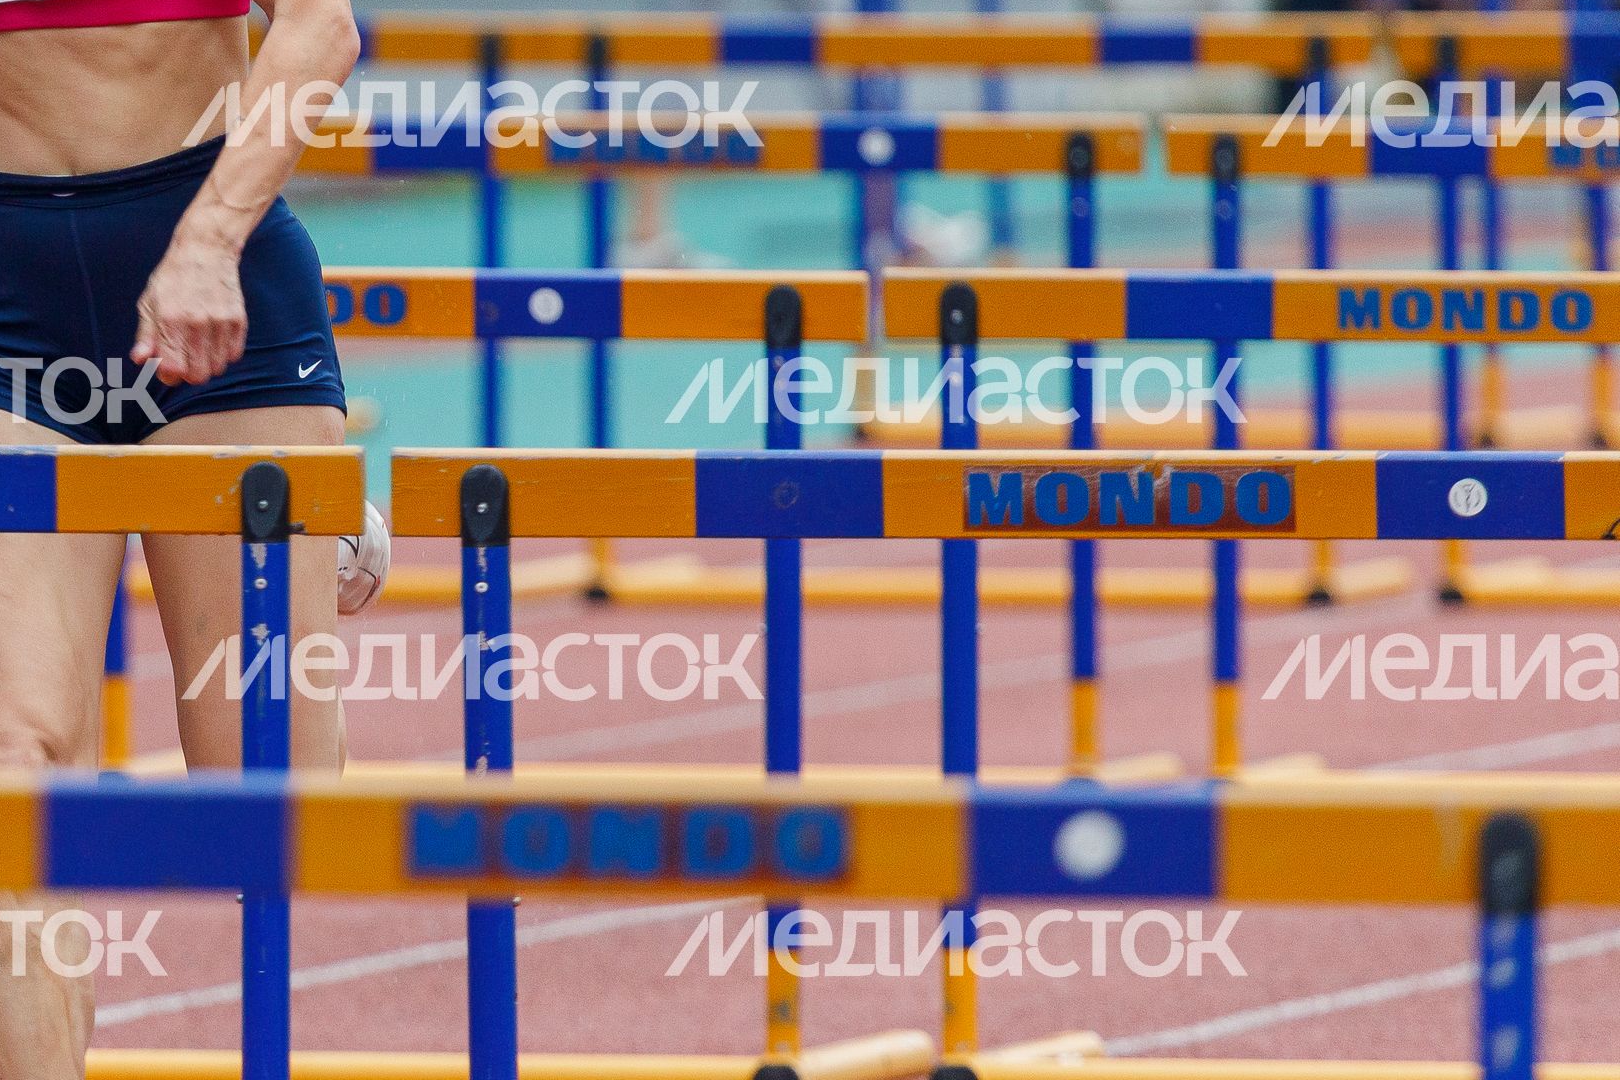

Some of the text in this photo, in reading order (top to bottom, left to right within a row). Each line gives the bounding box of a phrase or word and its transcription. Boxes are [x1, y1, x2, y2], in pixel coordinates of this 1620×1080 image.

[1337, 288, 1595, 332] MONDO
[968, 470, 1291, 525] MONDO
[408, 802, 852, 877] MONDO
